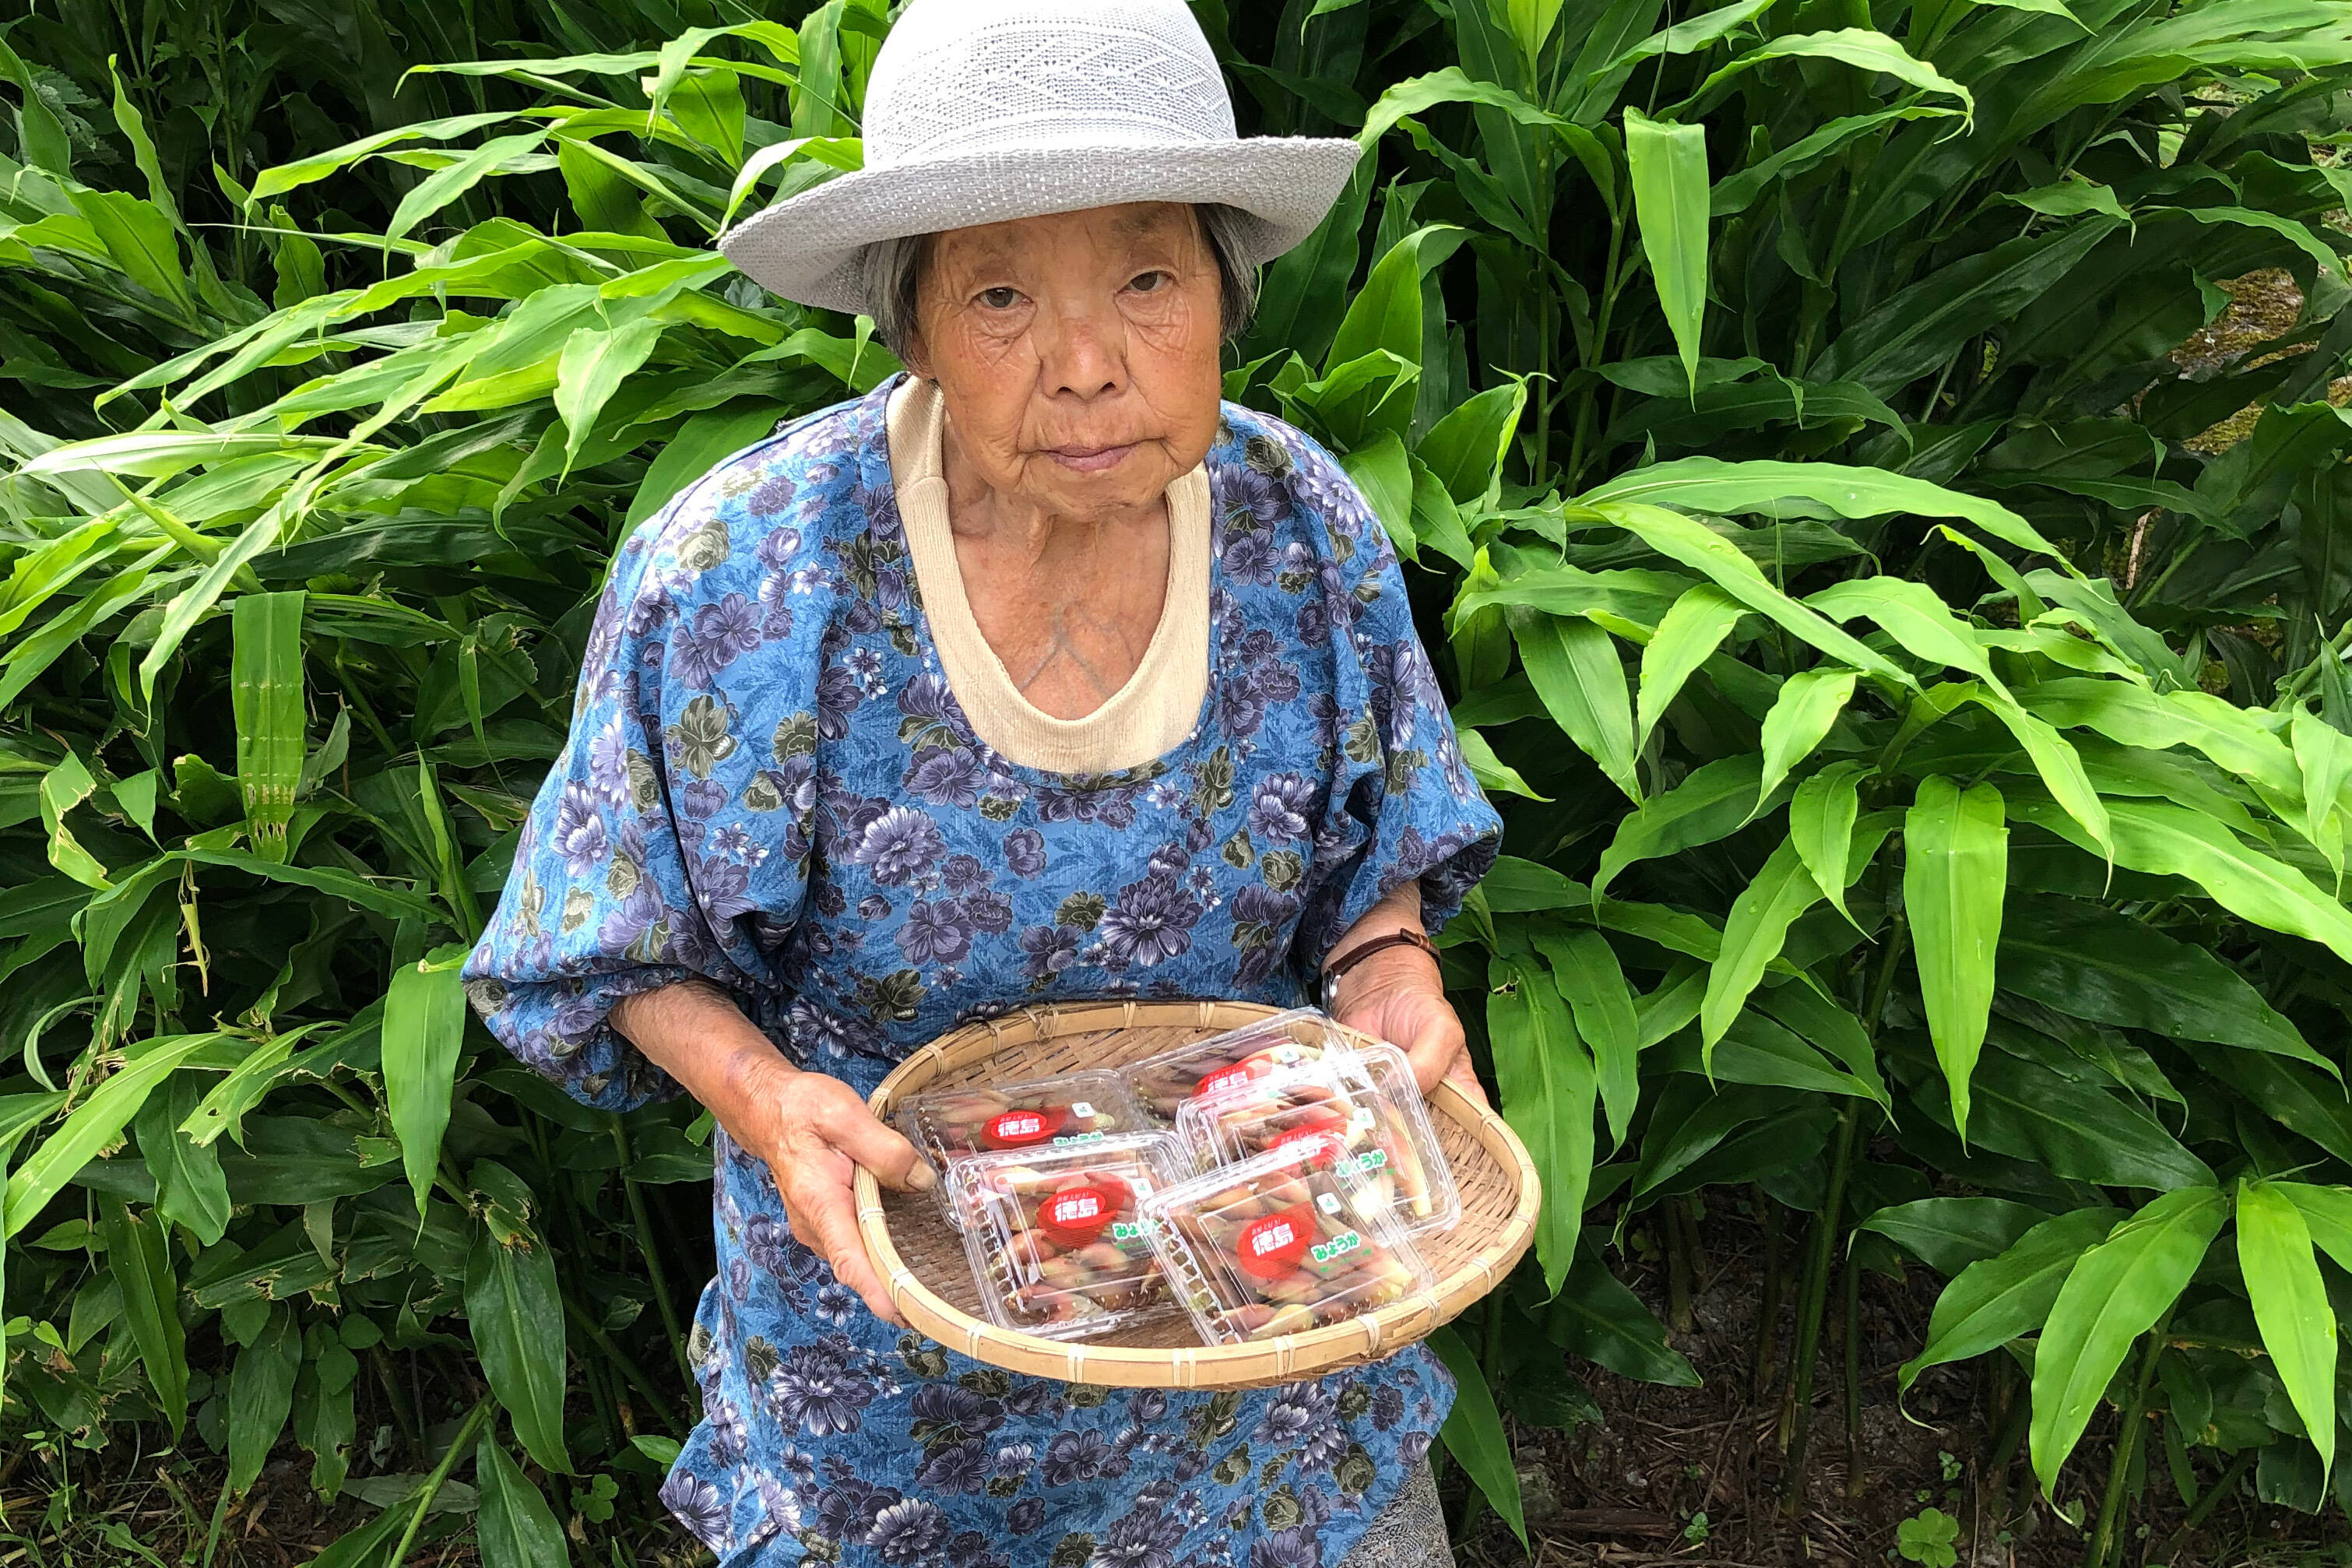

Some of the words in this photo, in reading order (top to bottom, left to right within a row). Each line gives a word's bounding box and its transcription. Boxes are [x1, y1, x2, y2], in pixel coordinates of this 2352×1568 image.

[997, 1118, 1040, 1137] 徳島
[1054, 1197, 1099, 1222] 徳島
[1251, 1222, 1295, 1257] 徳島
